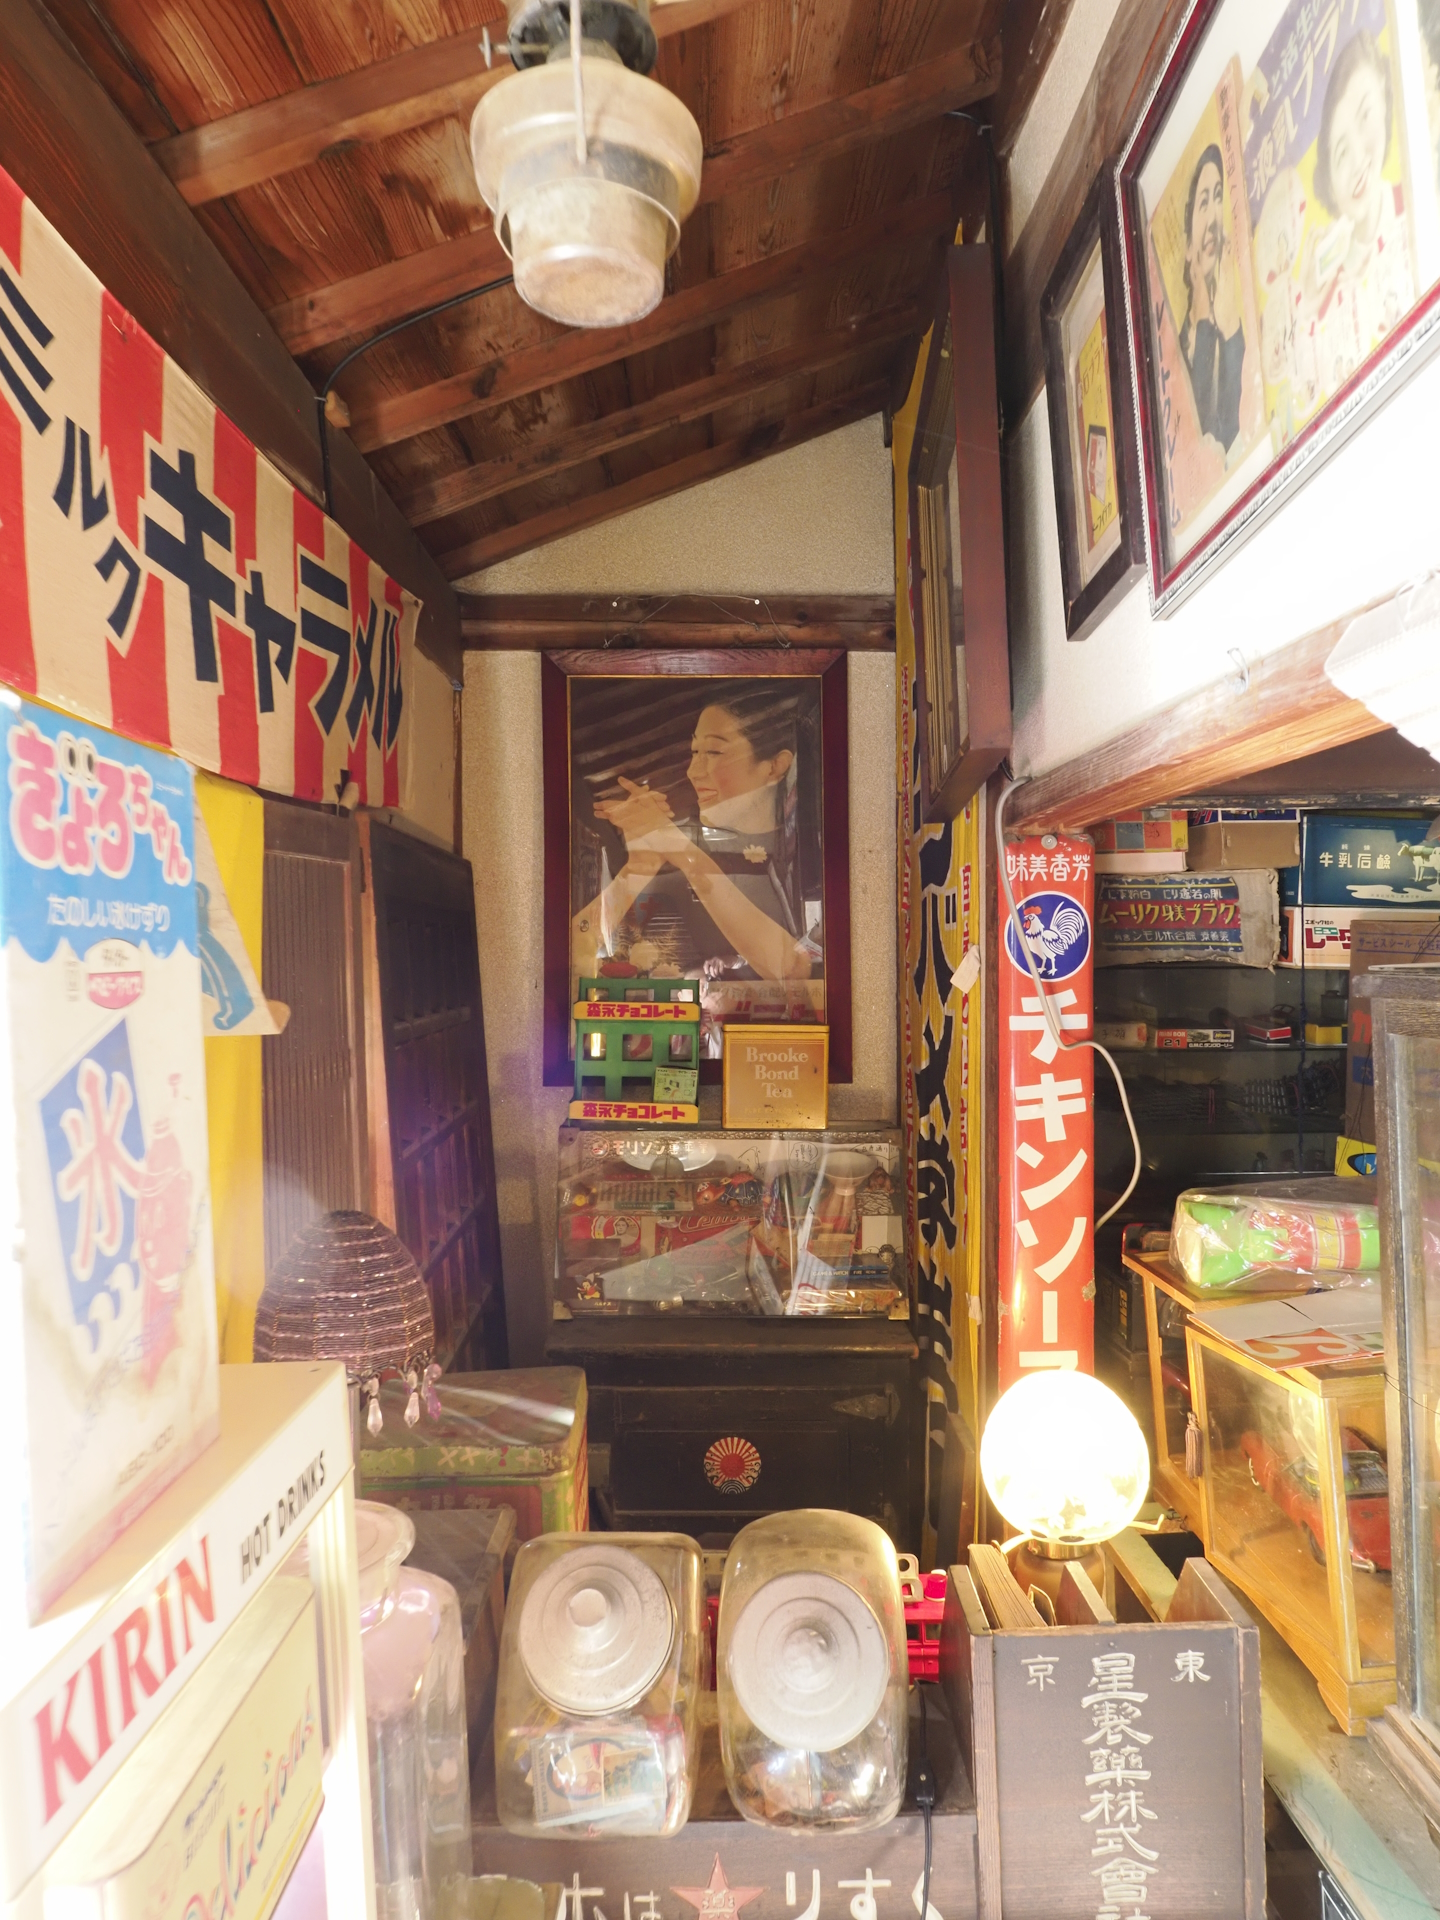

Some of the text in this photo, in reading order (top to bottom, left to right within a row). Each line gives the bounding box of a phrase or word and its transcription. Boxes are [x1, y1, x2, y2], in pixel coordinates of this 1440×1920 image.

[1315, 927, 1337, 935] ニュー
[586, 1003, 687, 1019] 森永チョコレート
[1164, 1038, 1181, 1048] 21
[746, 1047, 809, 1063] Brooke
[754, 1064, 800, 1080] Bond
[761, 1082, 793, 1098] Tea
[583, 1103, 686, 1120] 森永チョコレート
[240, 1449, 326, 1585] HOT DRINKS
[33, 1535, 217, 1827] KIRIN
